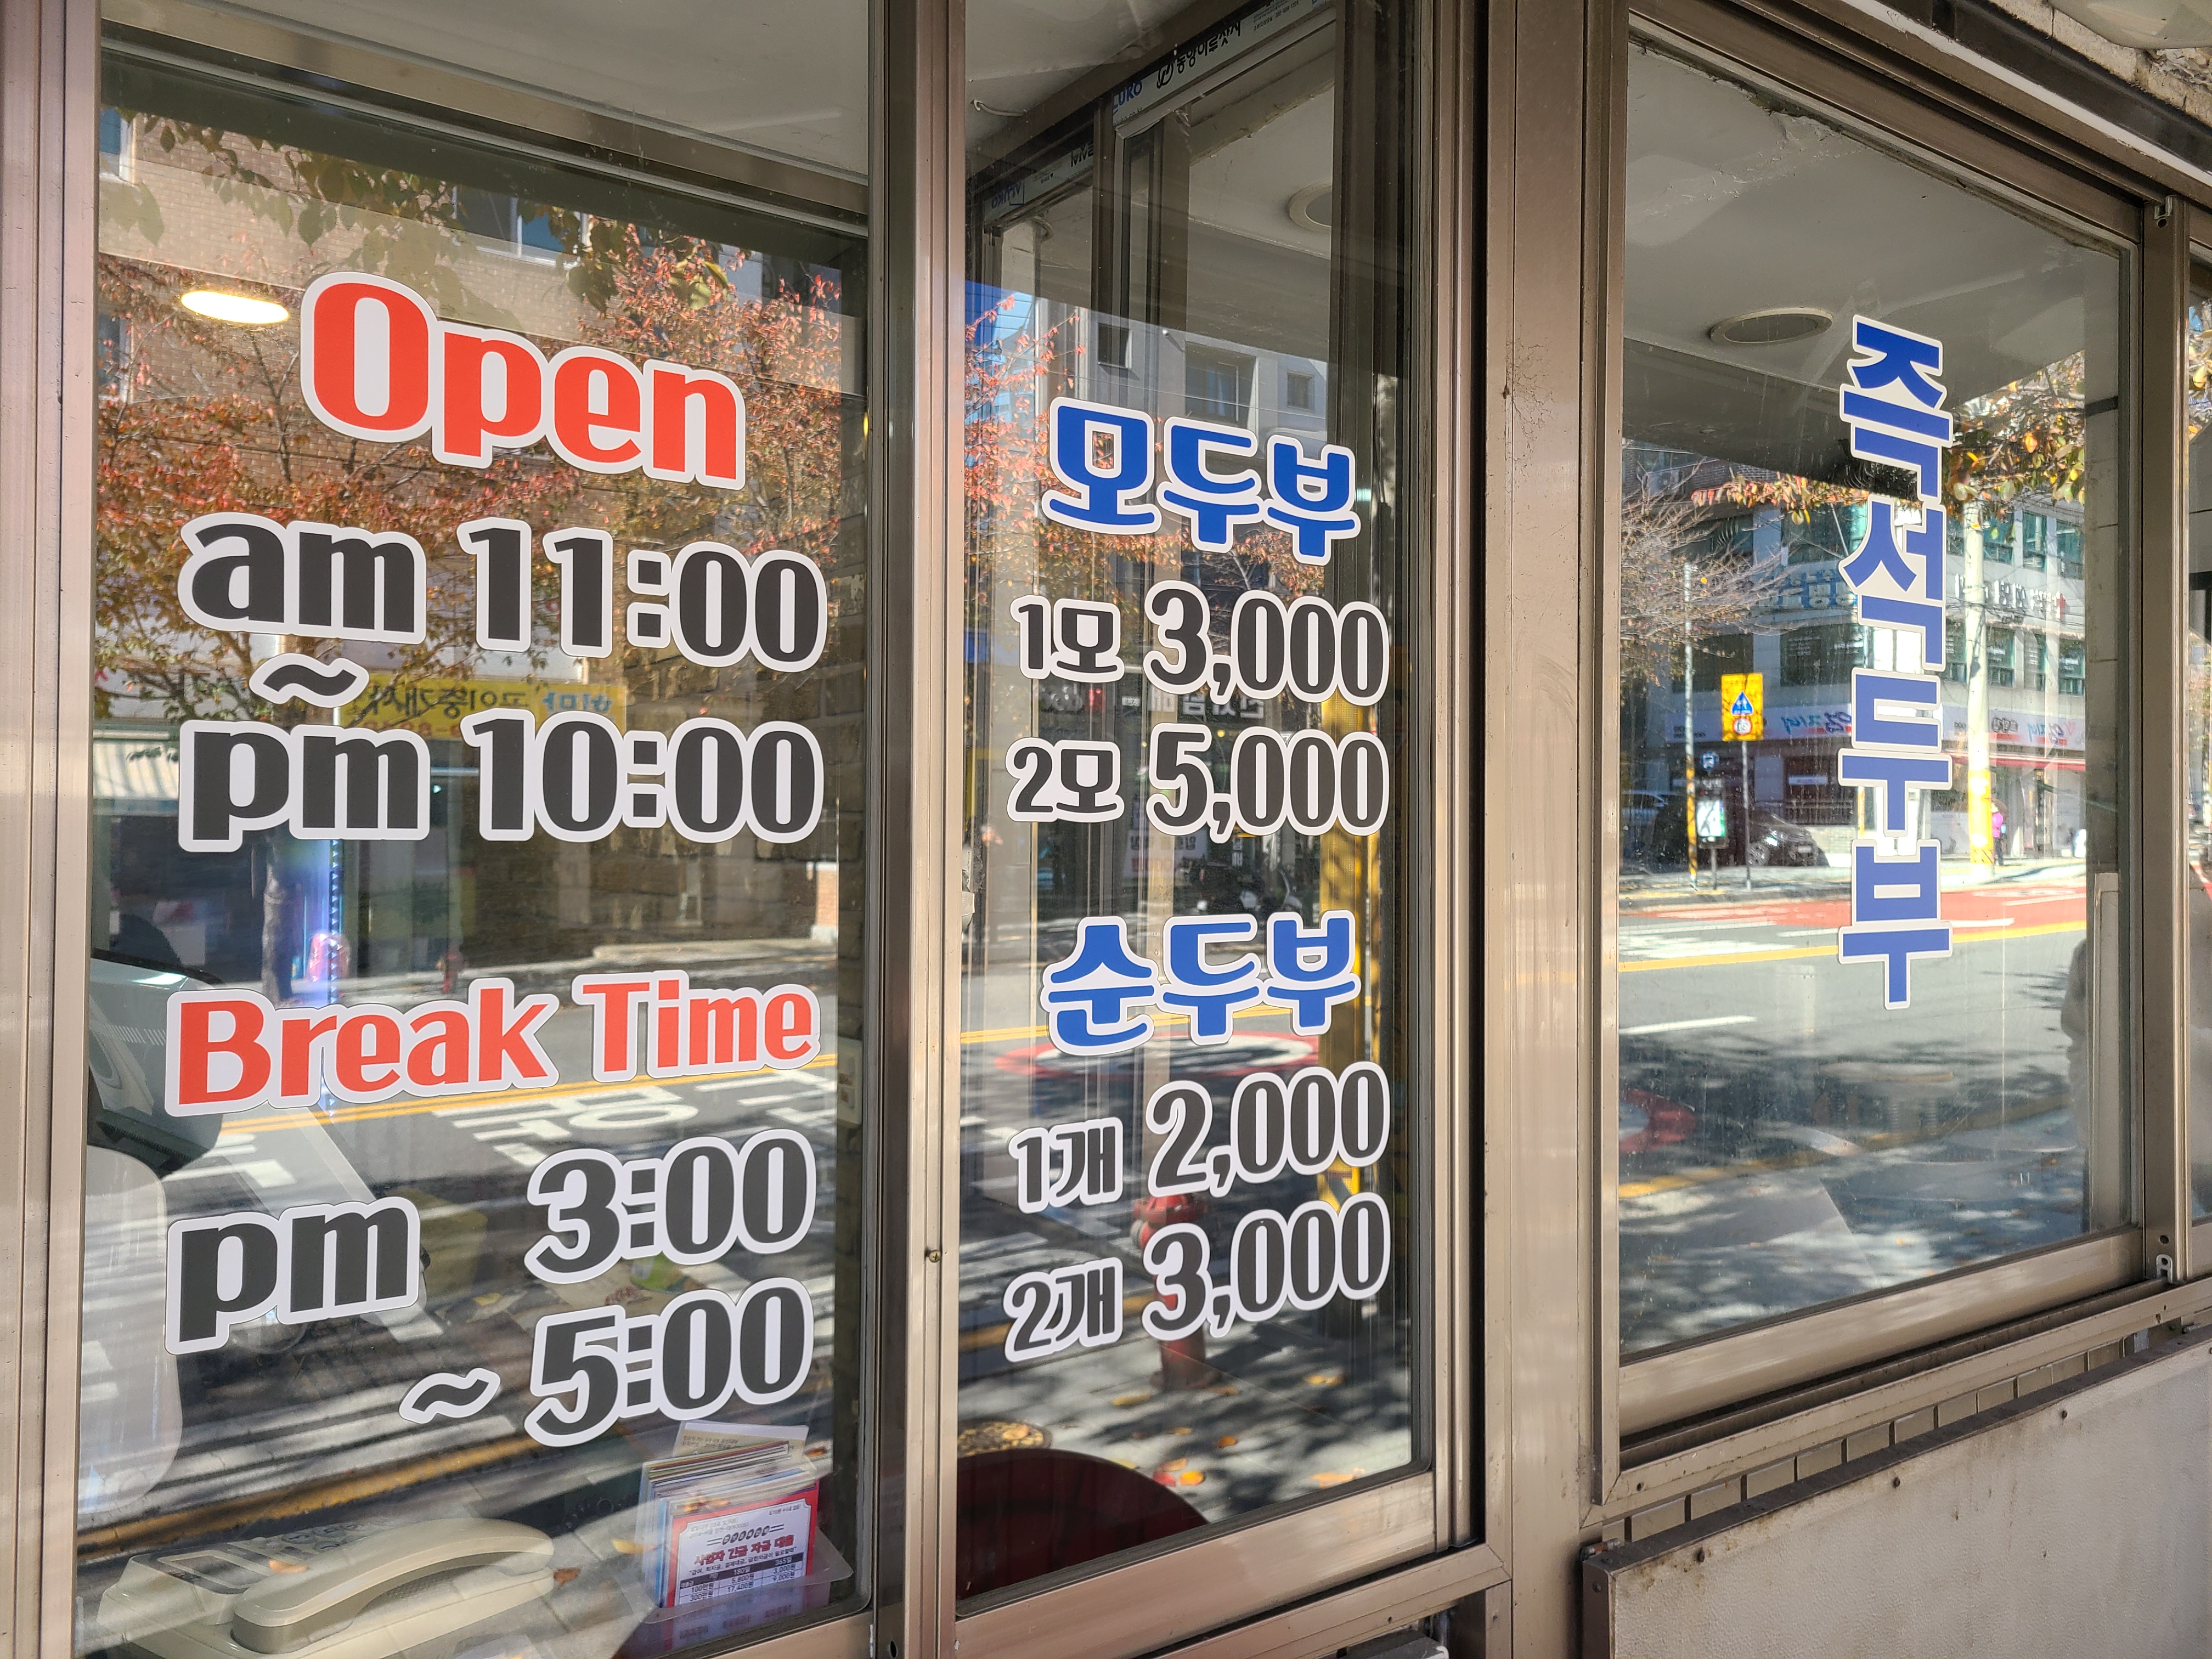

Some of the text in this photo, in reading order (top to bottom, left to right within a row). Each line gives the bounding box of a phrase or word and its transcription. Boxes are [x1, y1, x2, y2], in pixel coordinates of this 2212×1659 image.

[1113, 81, 1142, 108] LUKO
[313, 282, 738, 481] Open
[1049, 406, 1356, 557] 모두부
[191, 523, 820, 663] am 11:00
[1018, 588, 1385, 701] 1모 3,000
[1842, 321, 1950, 1003] 즉석두부
[193, 717, 816, 842] pm 10:00
[1013, 731, 1384, 836] 2모 5,000
[178, 979, 812, 1105] Break Time
[1048, 917, 1356, 1047] 순두부
[1017, 1069, 1385, 1205] 1개 2,000
[179, 1139, 808, 1344] pm 3:00
[1011, 1200, 1385, 1350] 2개 3,000
[536, 1286, 806, 1437] 5:00
[728, 1544, 748, 1560] 긴급
[751, 1539, 771, 1553] 자금
[774, 1534, 794, 1548] 대출
